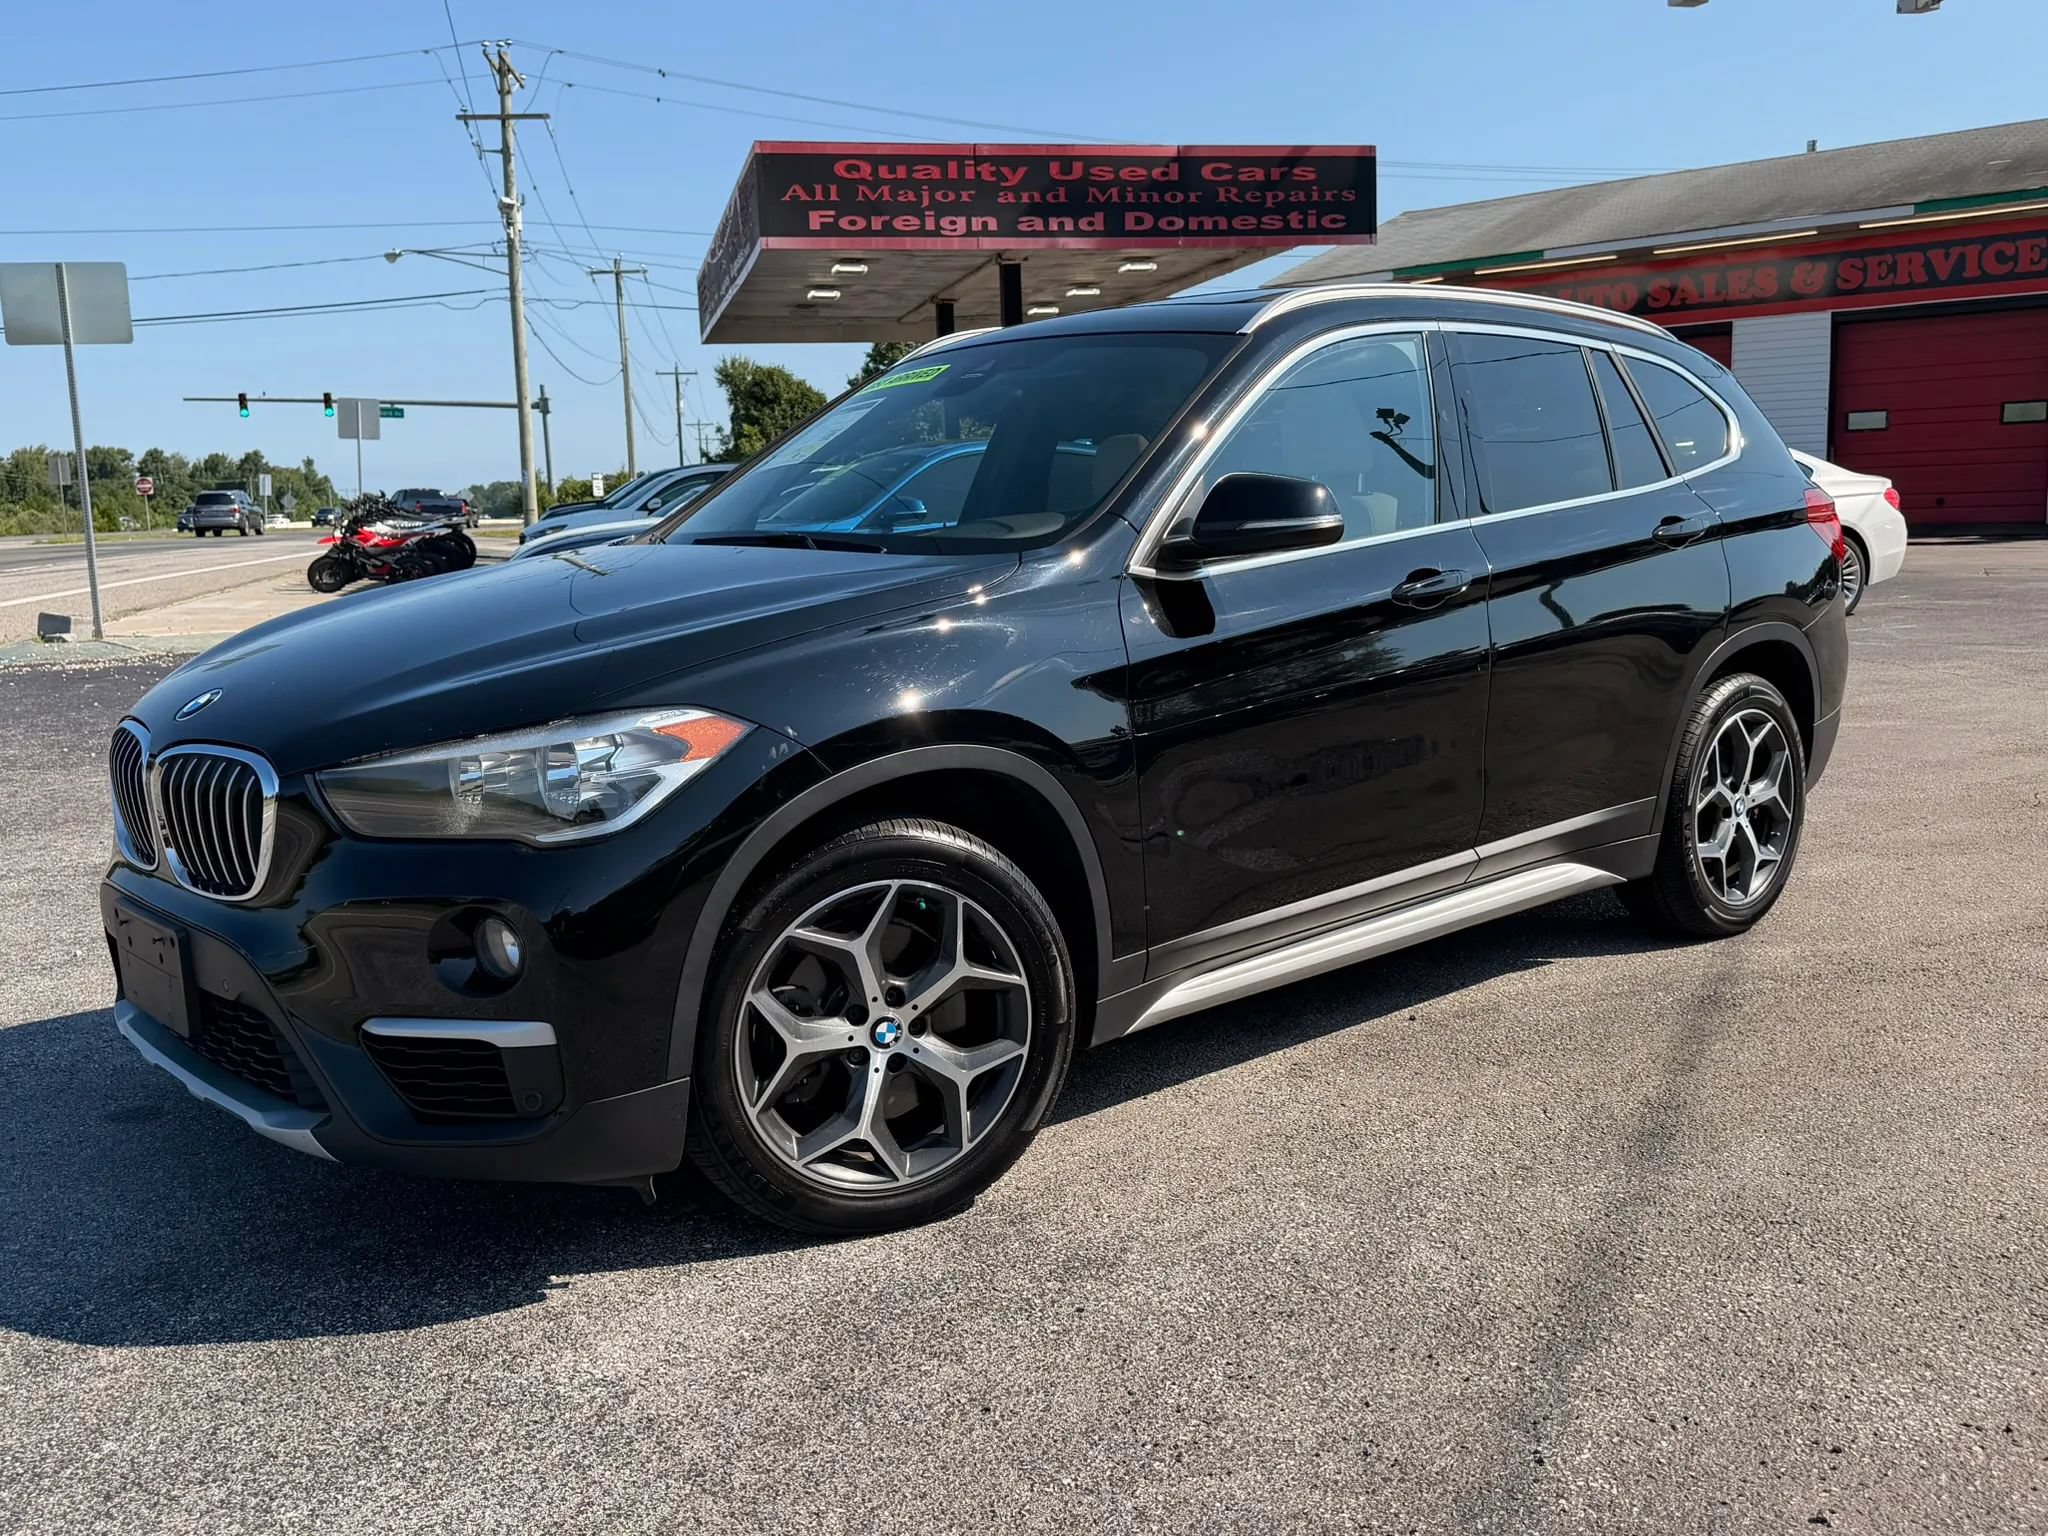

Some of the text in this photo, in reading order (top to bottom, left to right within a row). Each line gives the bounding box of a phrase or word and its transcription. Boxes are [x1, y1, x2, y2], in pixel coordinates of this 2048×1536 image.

[833, 159, 1318, 187] Quality Used Cars
[781, 183, 1356, 208] All Major and Minor Repairs
[808, 210, 1347, 236] Foreign and Domestic
[1557, 237, 2048, 312] TO SALES & SERVICE
